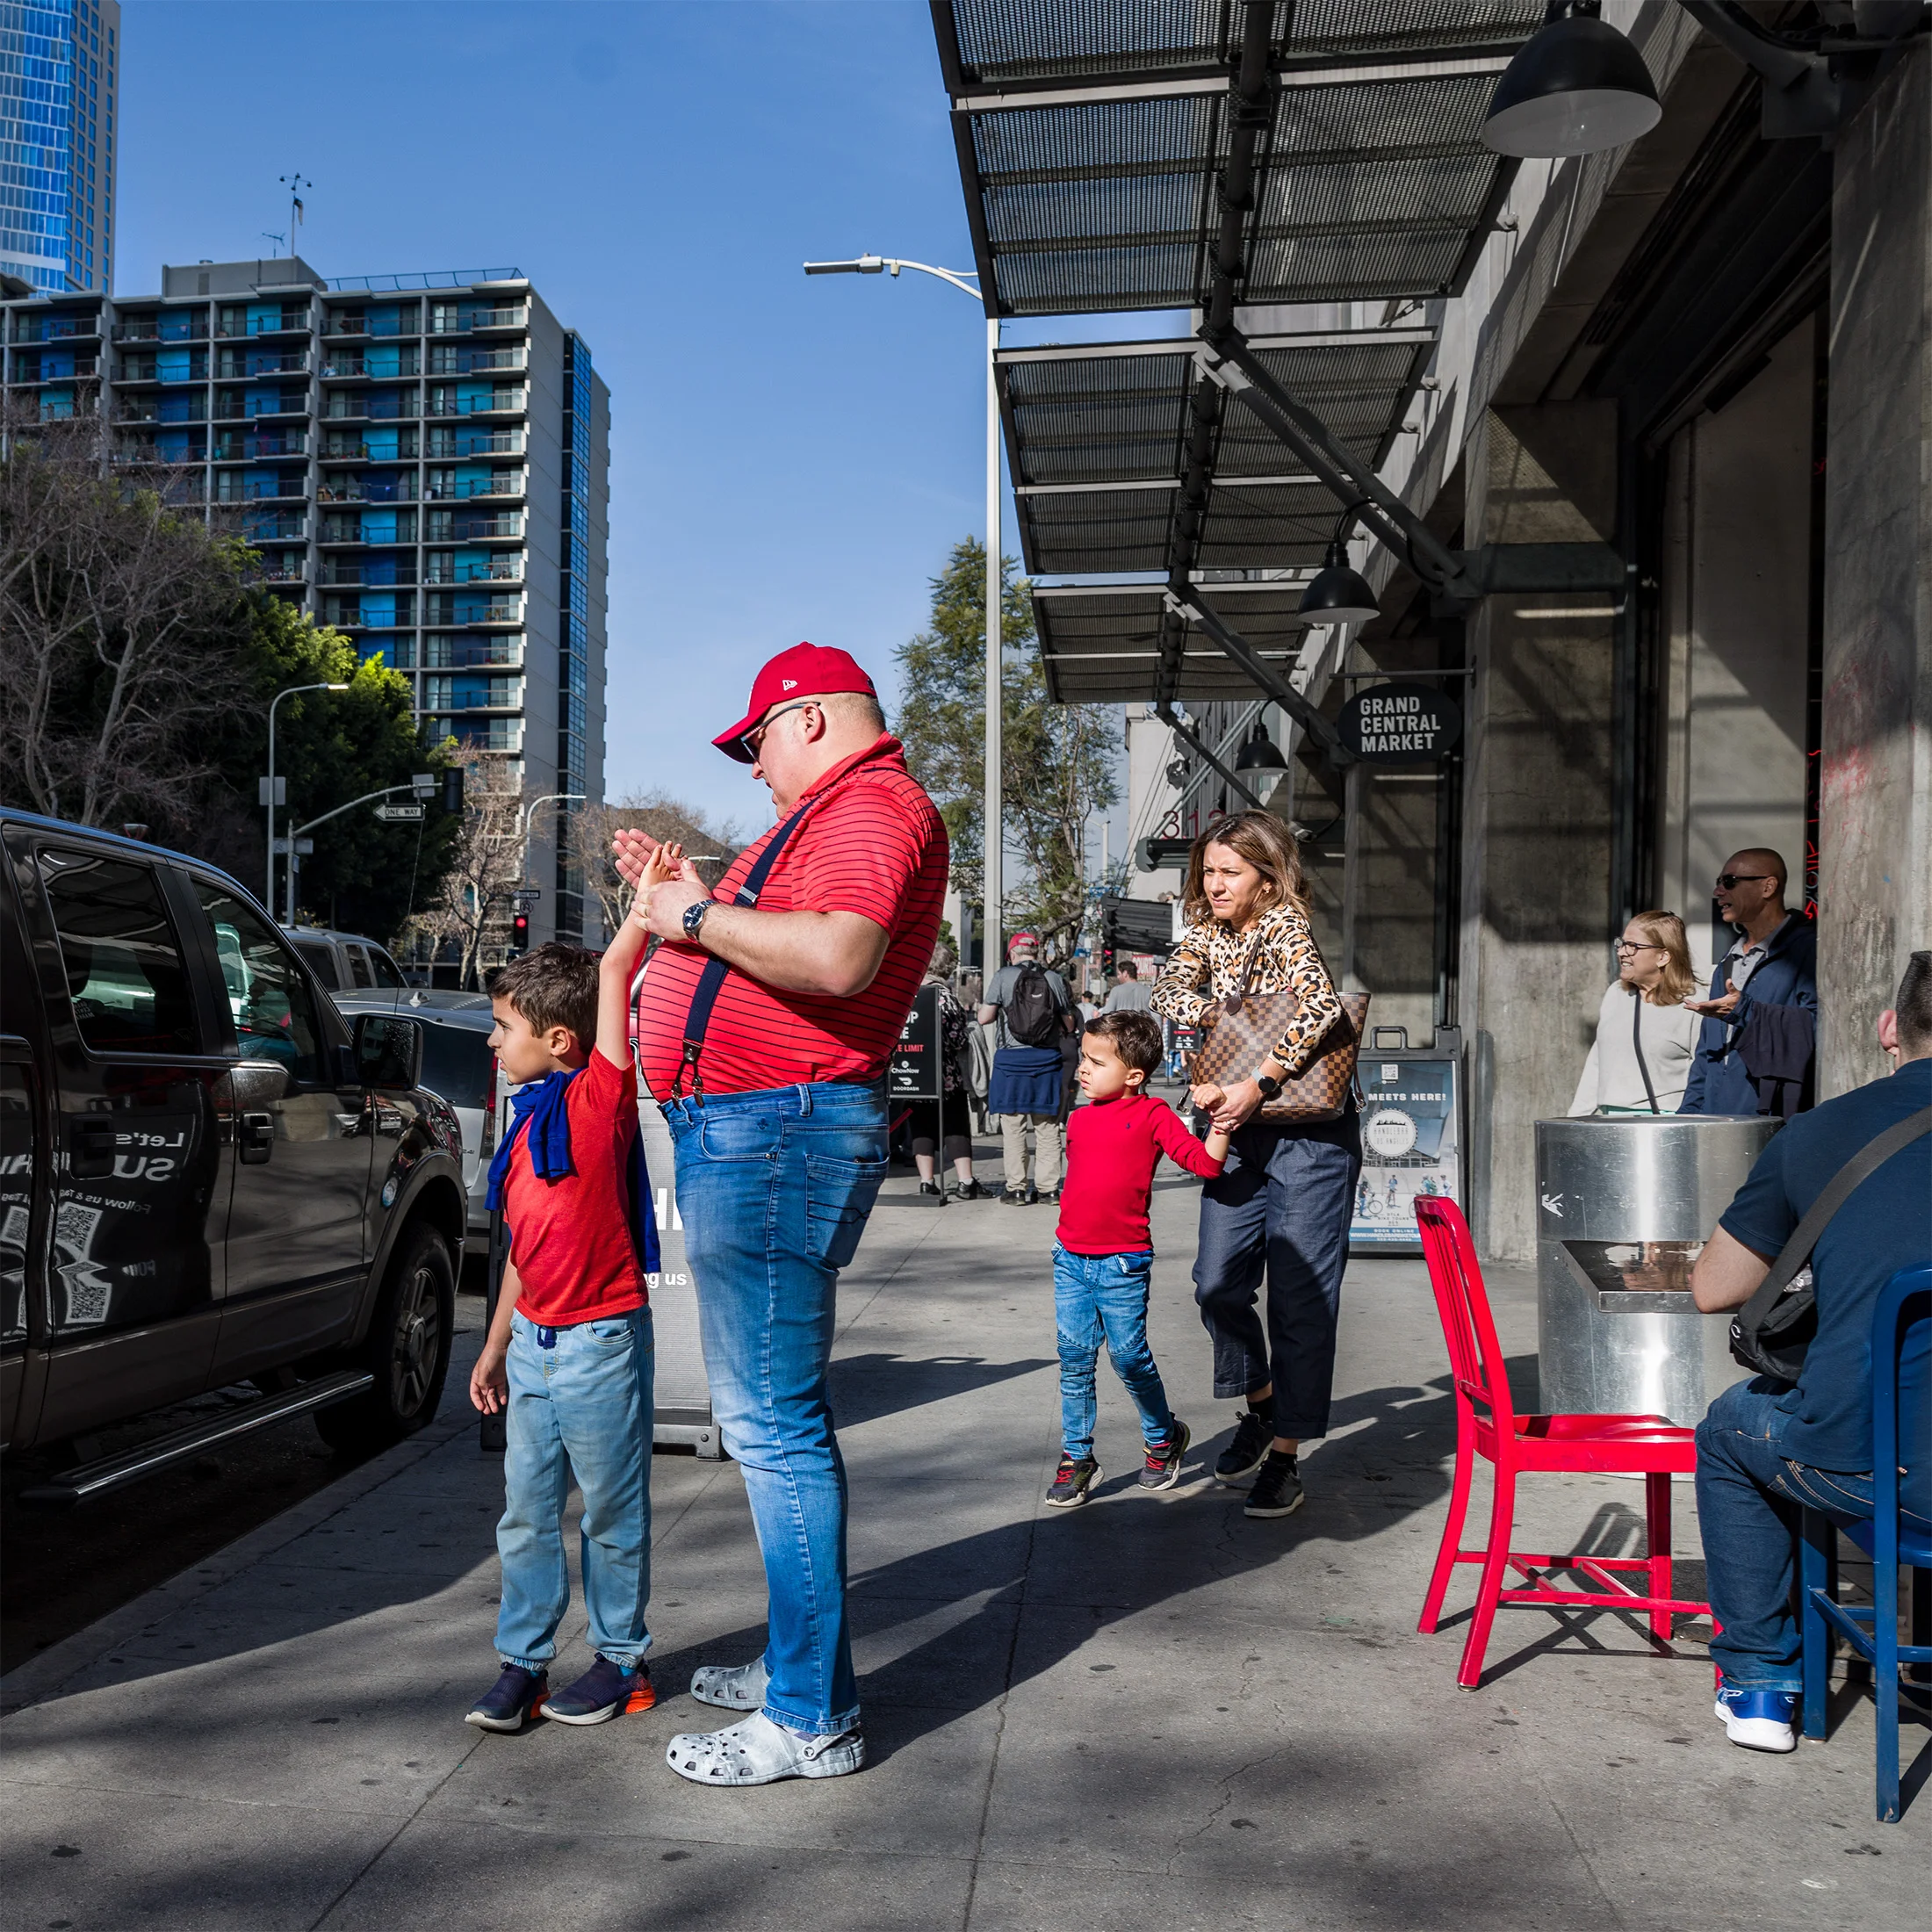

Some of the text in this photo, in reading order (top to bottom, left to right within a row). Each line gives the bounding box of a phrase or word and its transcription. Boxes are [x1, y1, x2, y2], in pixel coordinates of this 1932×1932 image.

[1359, 696, 1420, 716] GRAND
[1360, 714, 1441, 734] CENTRAL
[1361, 732, 1435, 753] MARKET
[1368, 1092, 1446, 1101] MEETS HERE!
[665, 1273, 688, 1286] us
